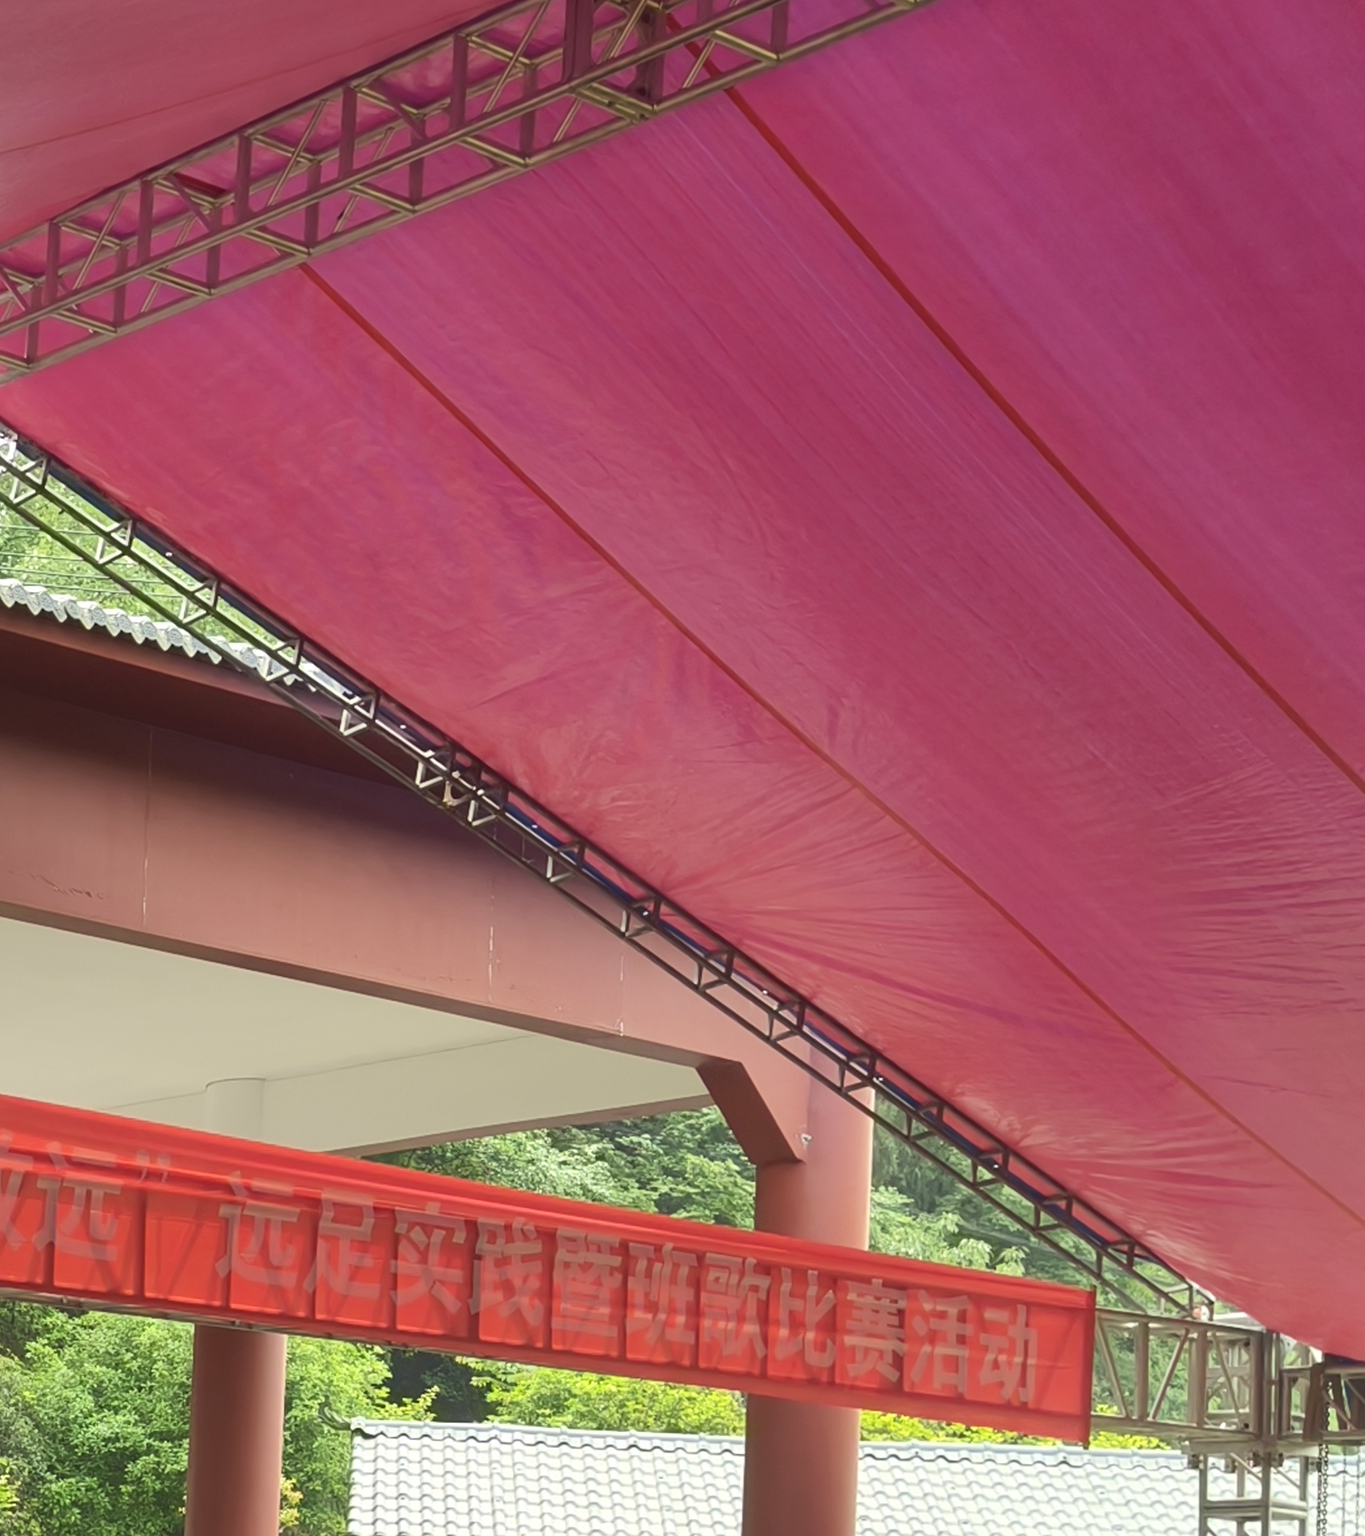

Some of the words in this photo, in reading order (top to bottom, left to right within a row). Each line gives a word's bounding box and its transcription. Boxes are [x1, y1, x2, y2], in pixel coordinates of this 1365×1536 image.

[215, 1171, 1038, 1407] 远足实践暨班歌比赛活动
